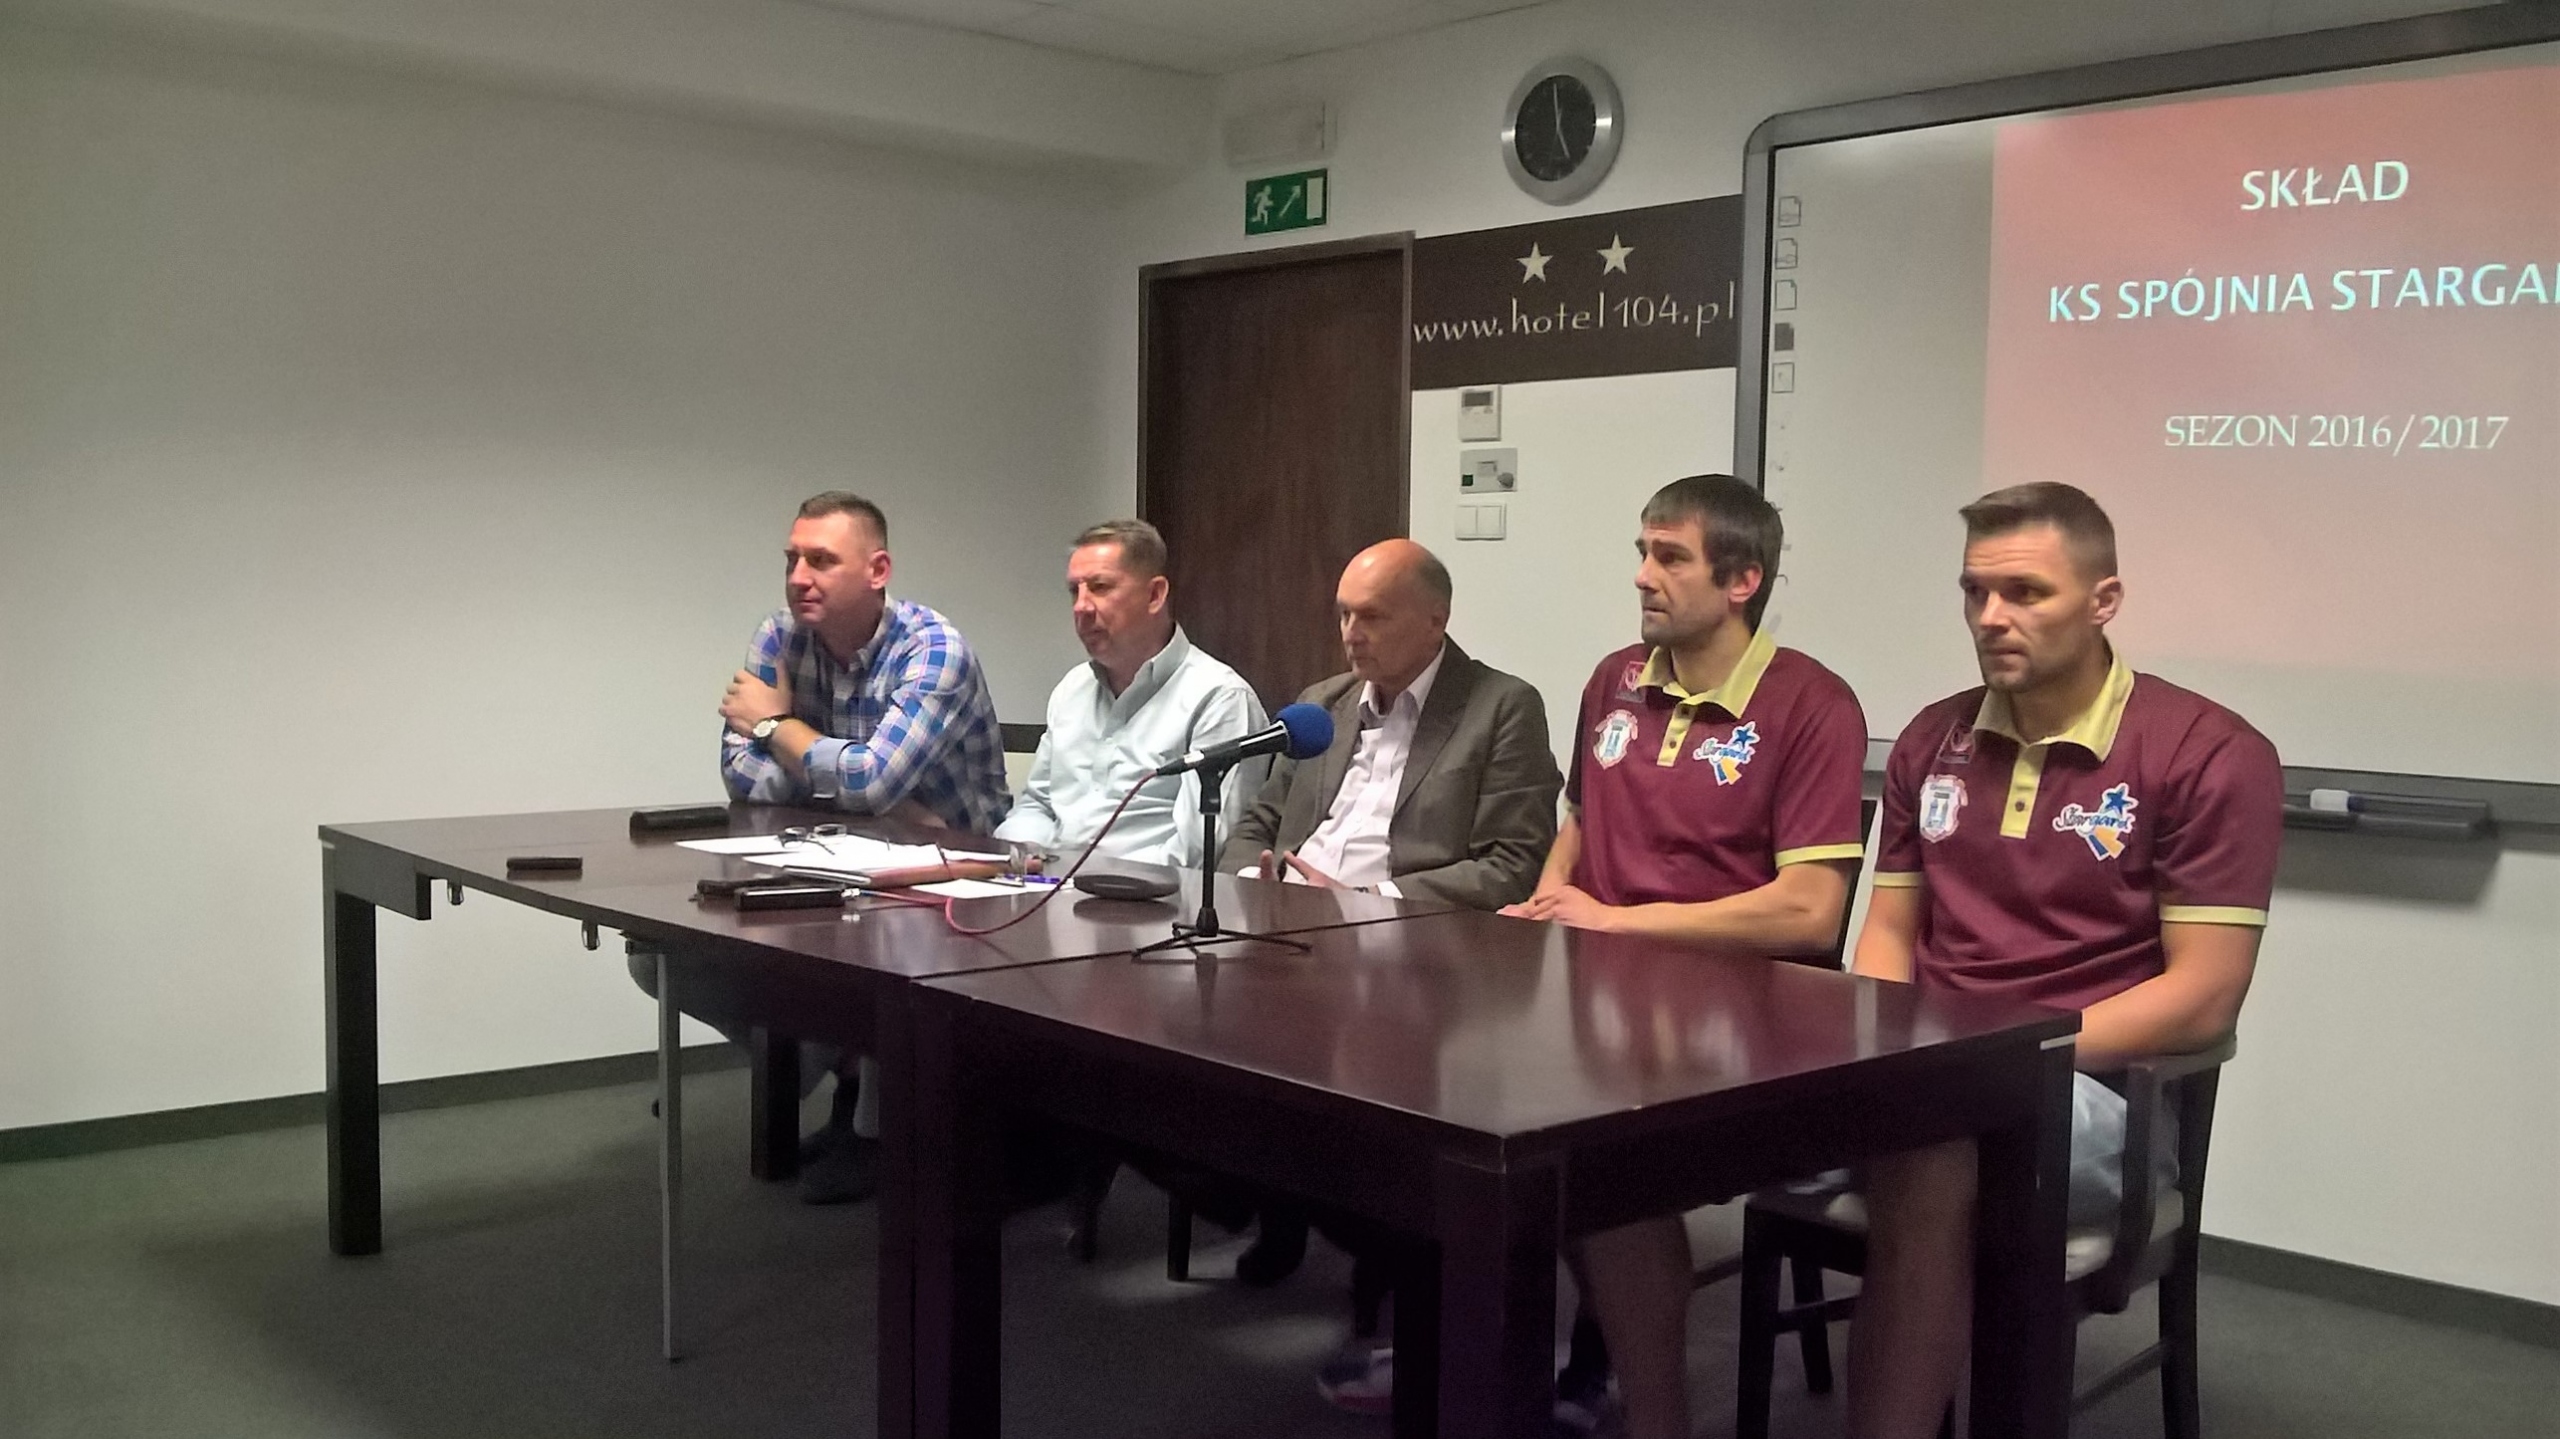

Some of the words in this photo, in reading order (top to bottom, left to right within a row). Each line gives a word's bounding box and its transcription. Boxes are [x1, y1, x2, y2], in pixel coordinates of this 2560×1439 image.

[2240, 160, 2410, 211] SKŁAD
[2048, 283, 2101, 322] KS
[2116, 268, 2314, 321] SPÓJNIA
[2164, 415, 2299, 448] SEZON
[2308, 414, 2510, 457] 2016/2017
